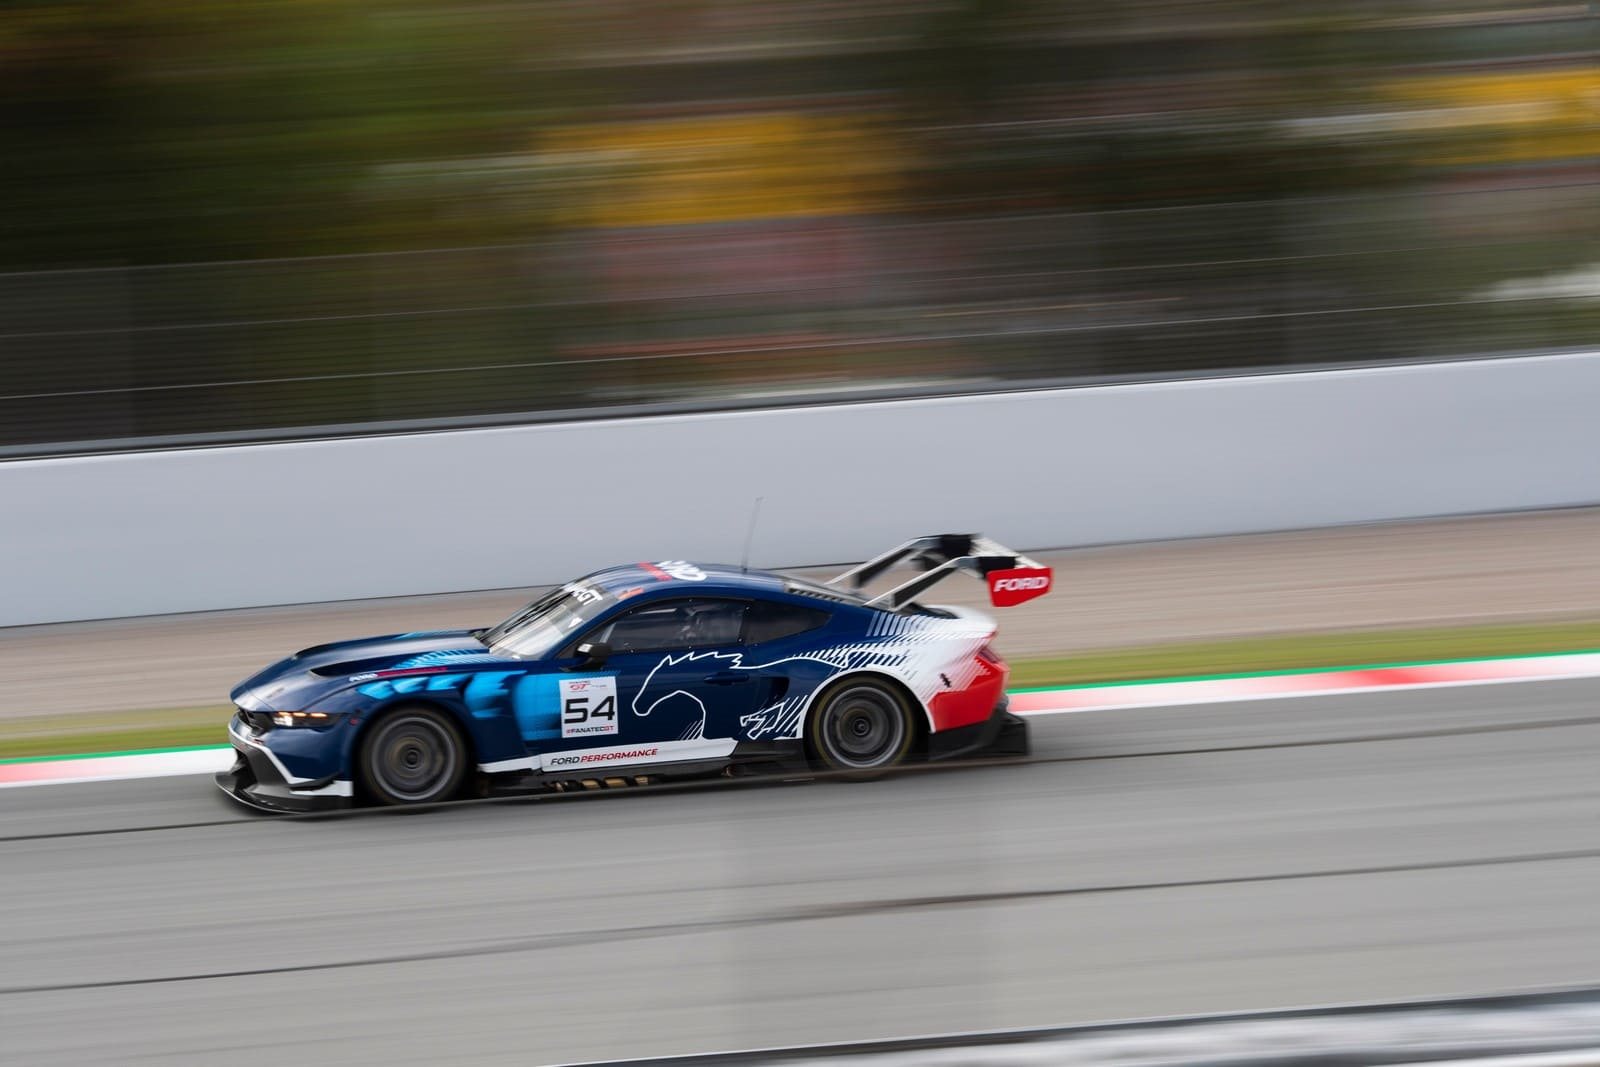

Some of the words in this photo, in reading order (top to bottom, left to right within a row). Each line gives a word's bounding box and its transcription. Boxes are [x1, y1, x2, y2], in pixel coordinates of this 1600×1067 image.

[993, 576, 1049, 592] FORD
[564, 695, 615, 724] 54
[550, 756, 580, 766] FORD
[580, 748, 658, 763] PERFORMANCE
